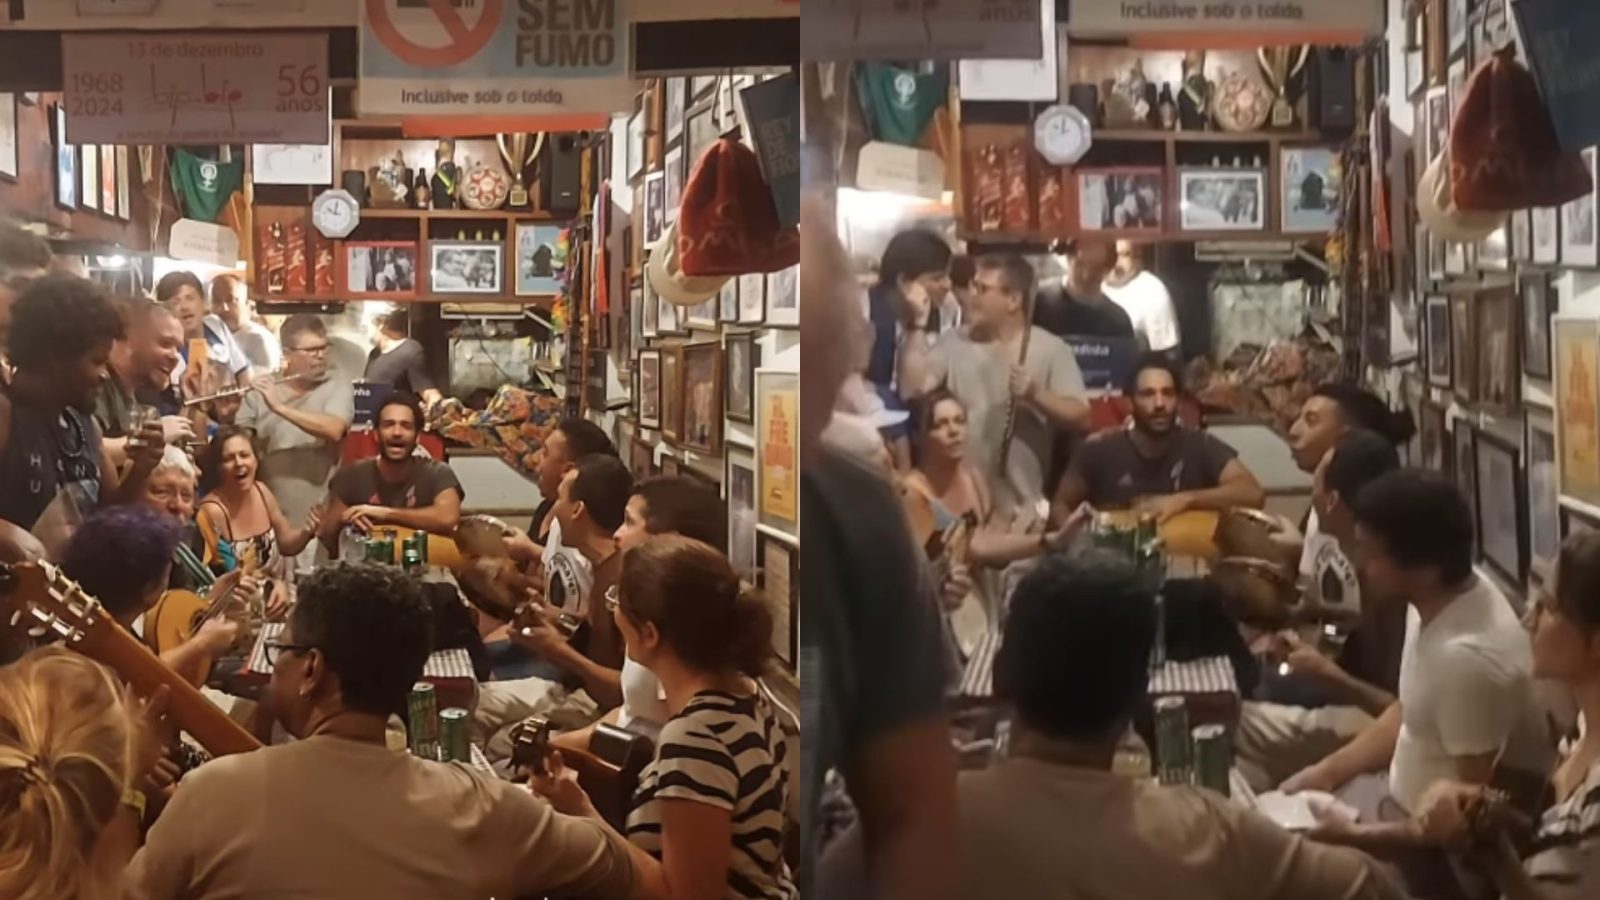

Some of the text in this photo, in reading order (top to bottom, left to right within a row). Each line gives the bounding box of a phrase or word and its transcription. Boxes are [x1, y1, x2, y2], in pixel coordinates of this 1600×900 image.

[516, 0, 616, 31] SEM
[1119, 1, 1198, 19] Inclusive
[1203, 2, 1235, 19] sob
[128, 42, 264, 58] 13 de dezembro
[515, 33, 616, 68] FUMO
[72, 72, 124, 94] 1968
[276, 64, 321, 97] 56
[401, 88, 469, 104] Inclusive
[475, 89, 502, 104] sob
[507, 92, 518, 104] o
[72, 98, 124, 117] 2024
[275, 100, 323, 114] anos
